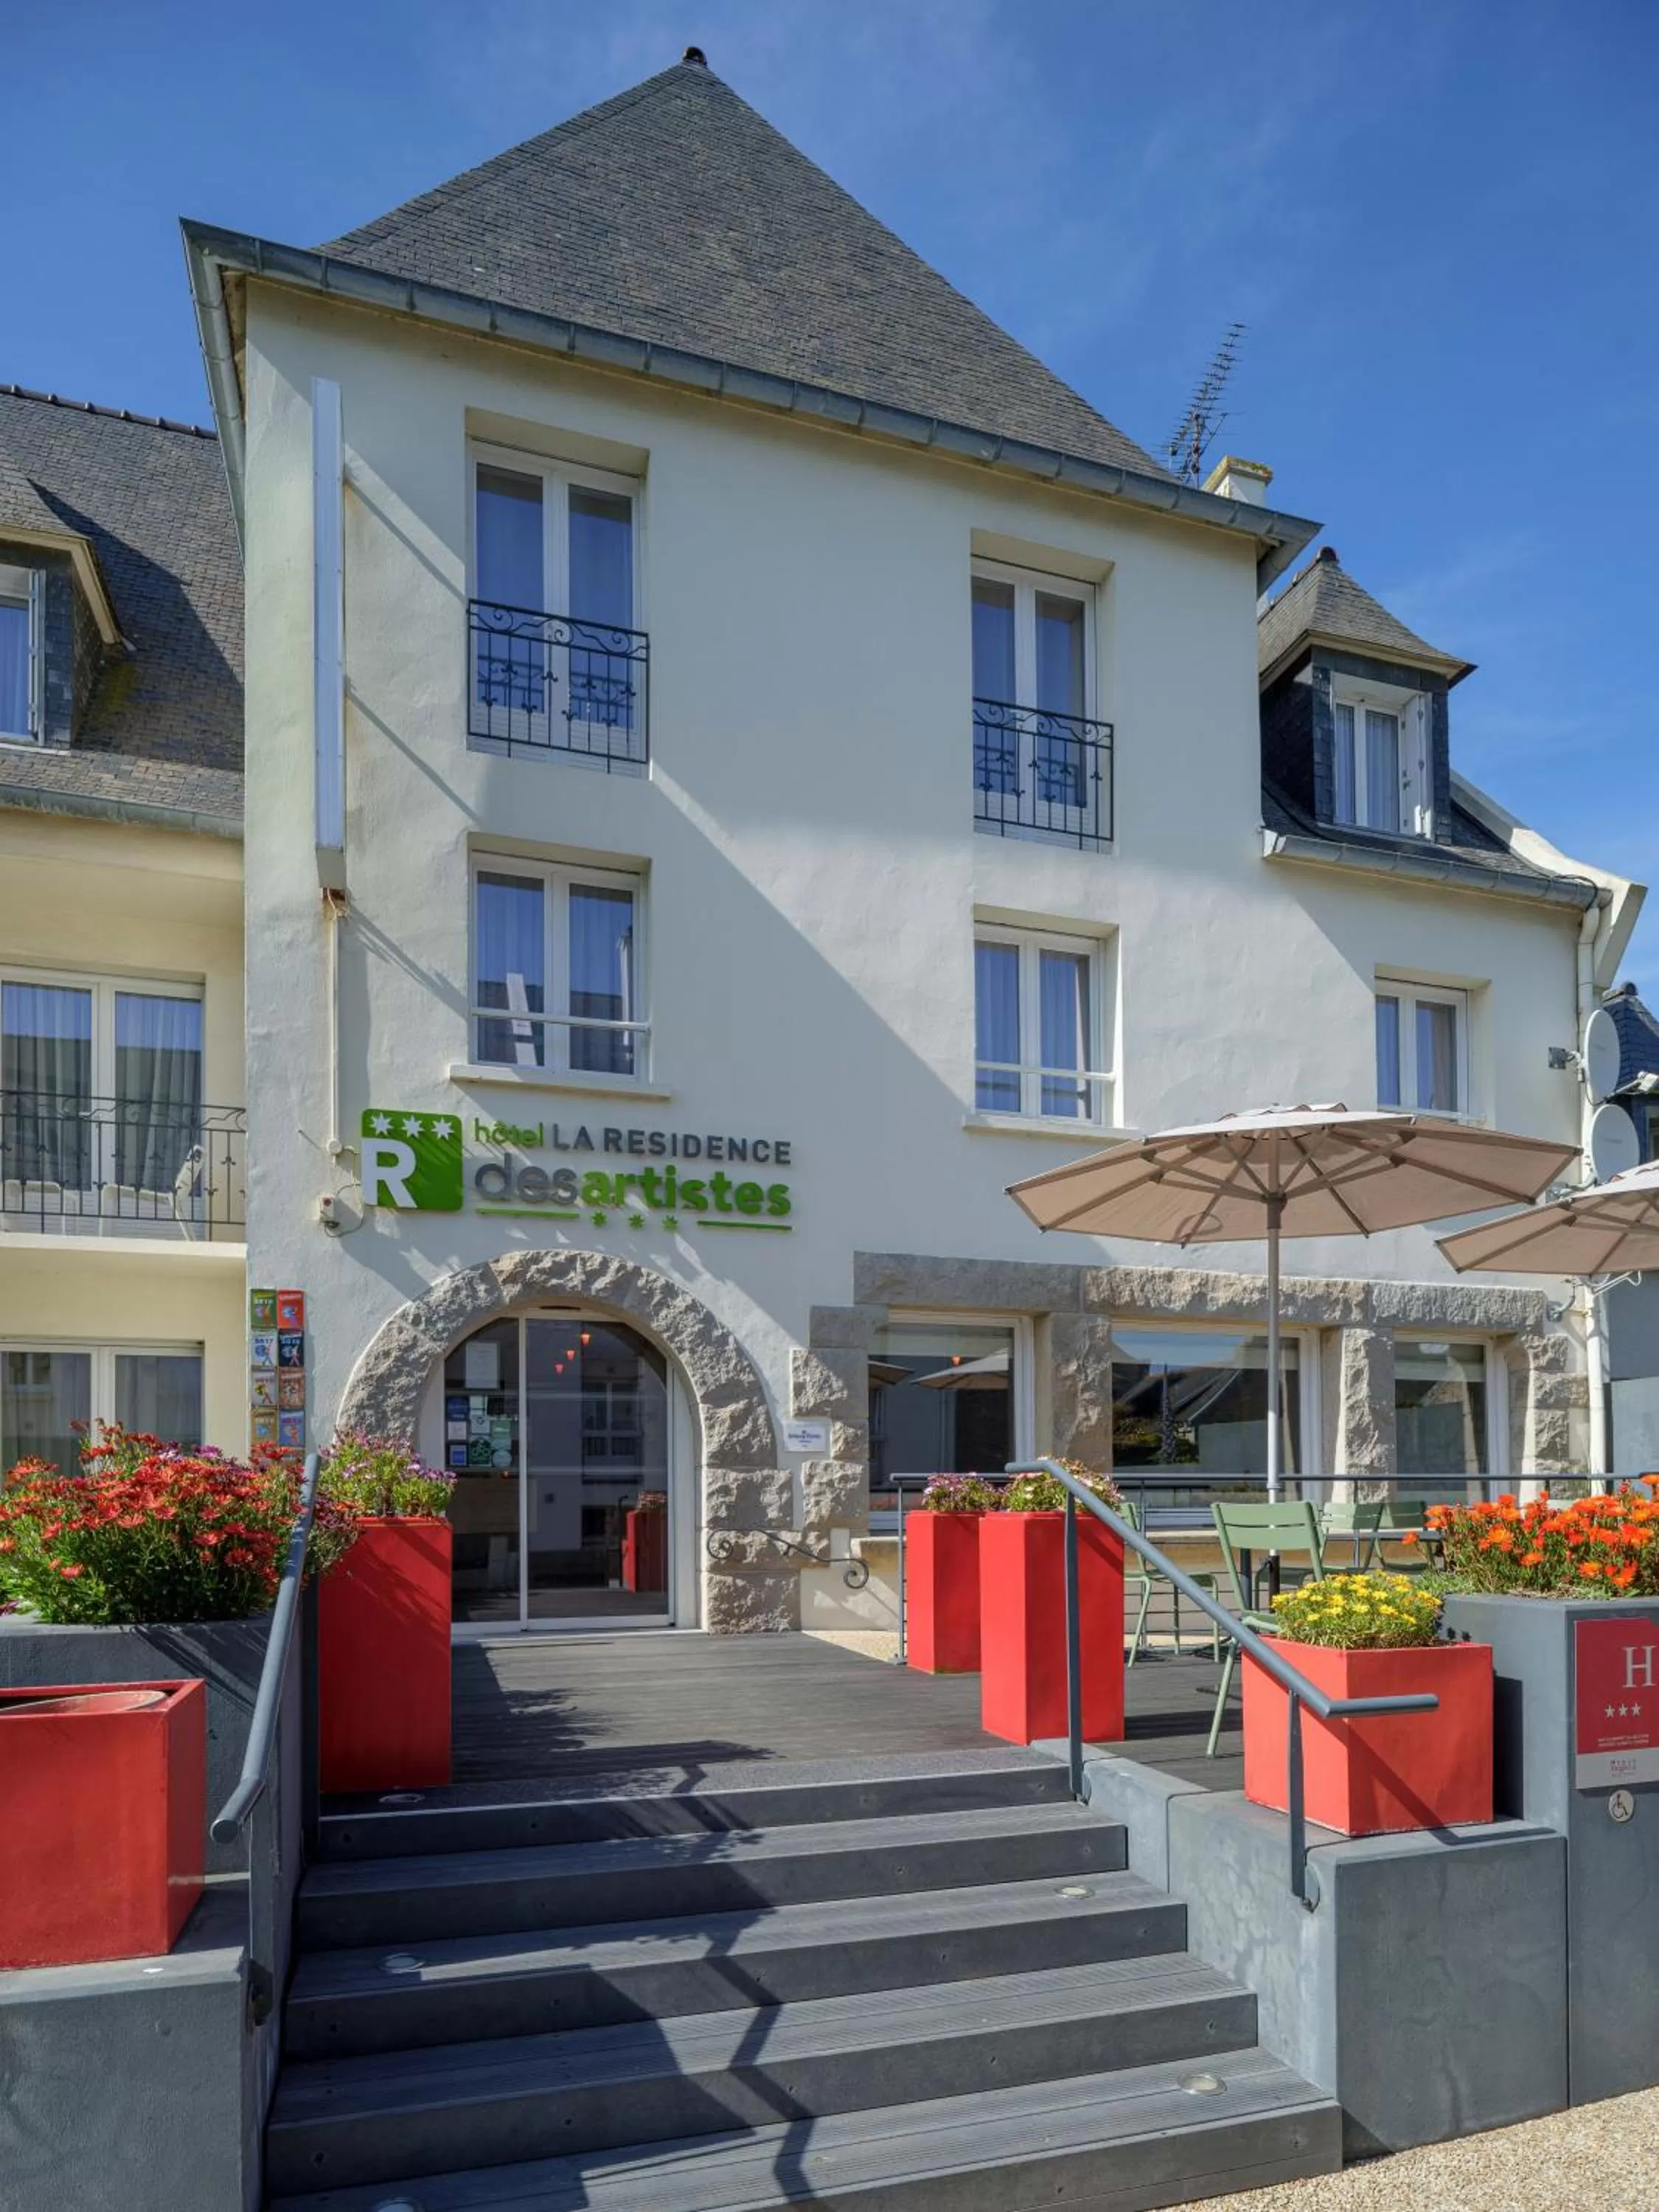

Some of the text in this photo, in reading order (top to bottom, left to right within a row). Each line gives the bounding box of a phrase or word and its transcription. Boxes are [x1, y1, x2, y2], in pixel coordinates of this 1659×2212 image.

[474, 1117, 791, 1165] hôtel LA RESIDENCE
[361, 1137, 419, 1208] R
[1622, 1645, 1658, 1688] H
